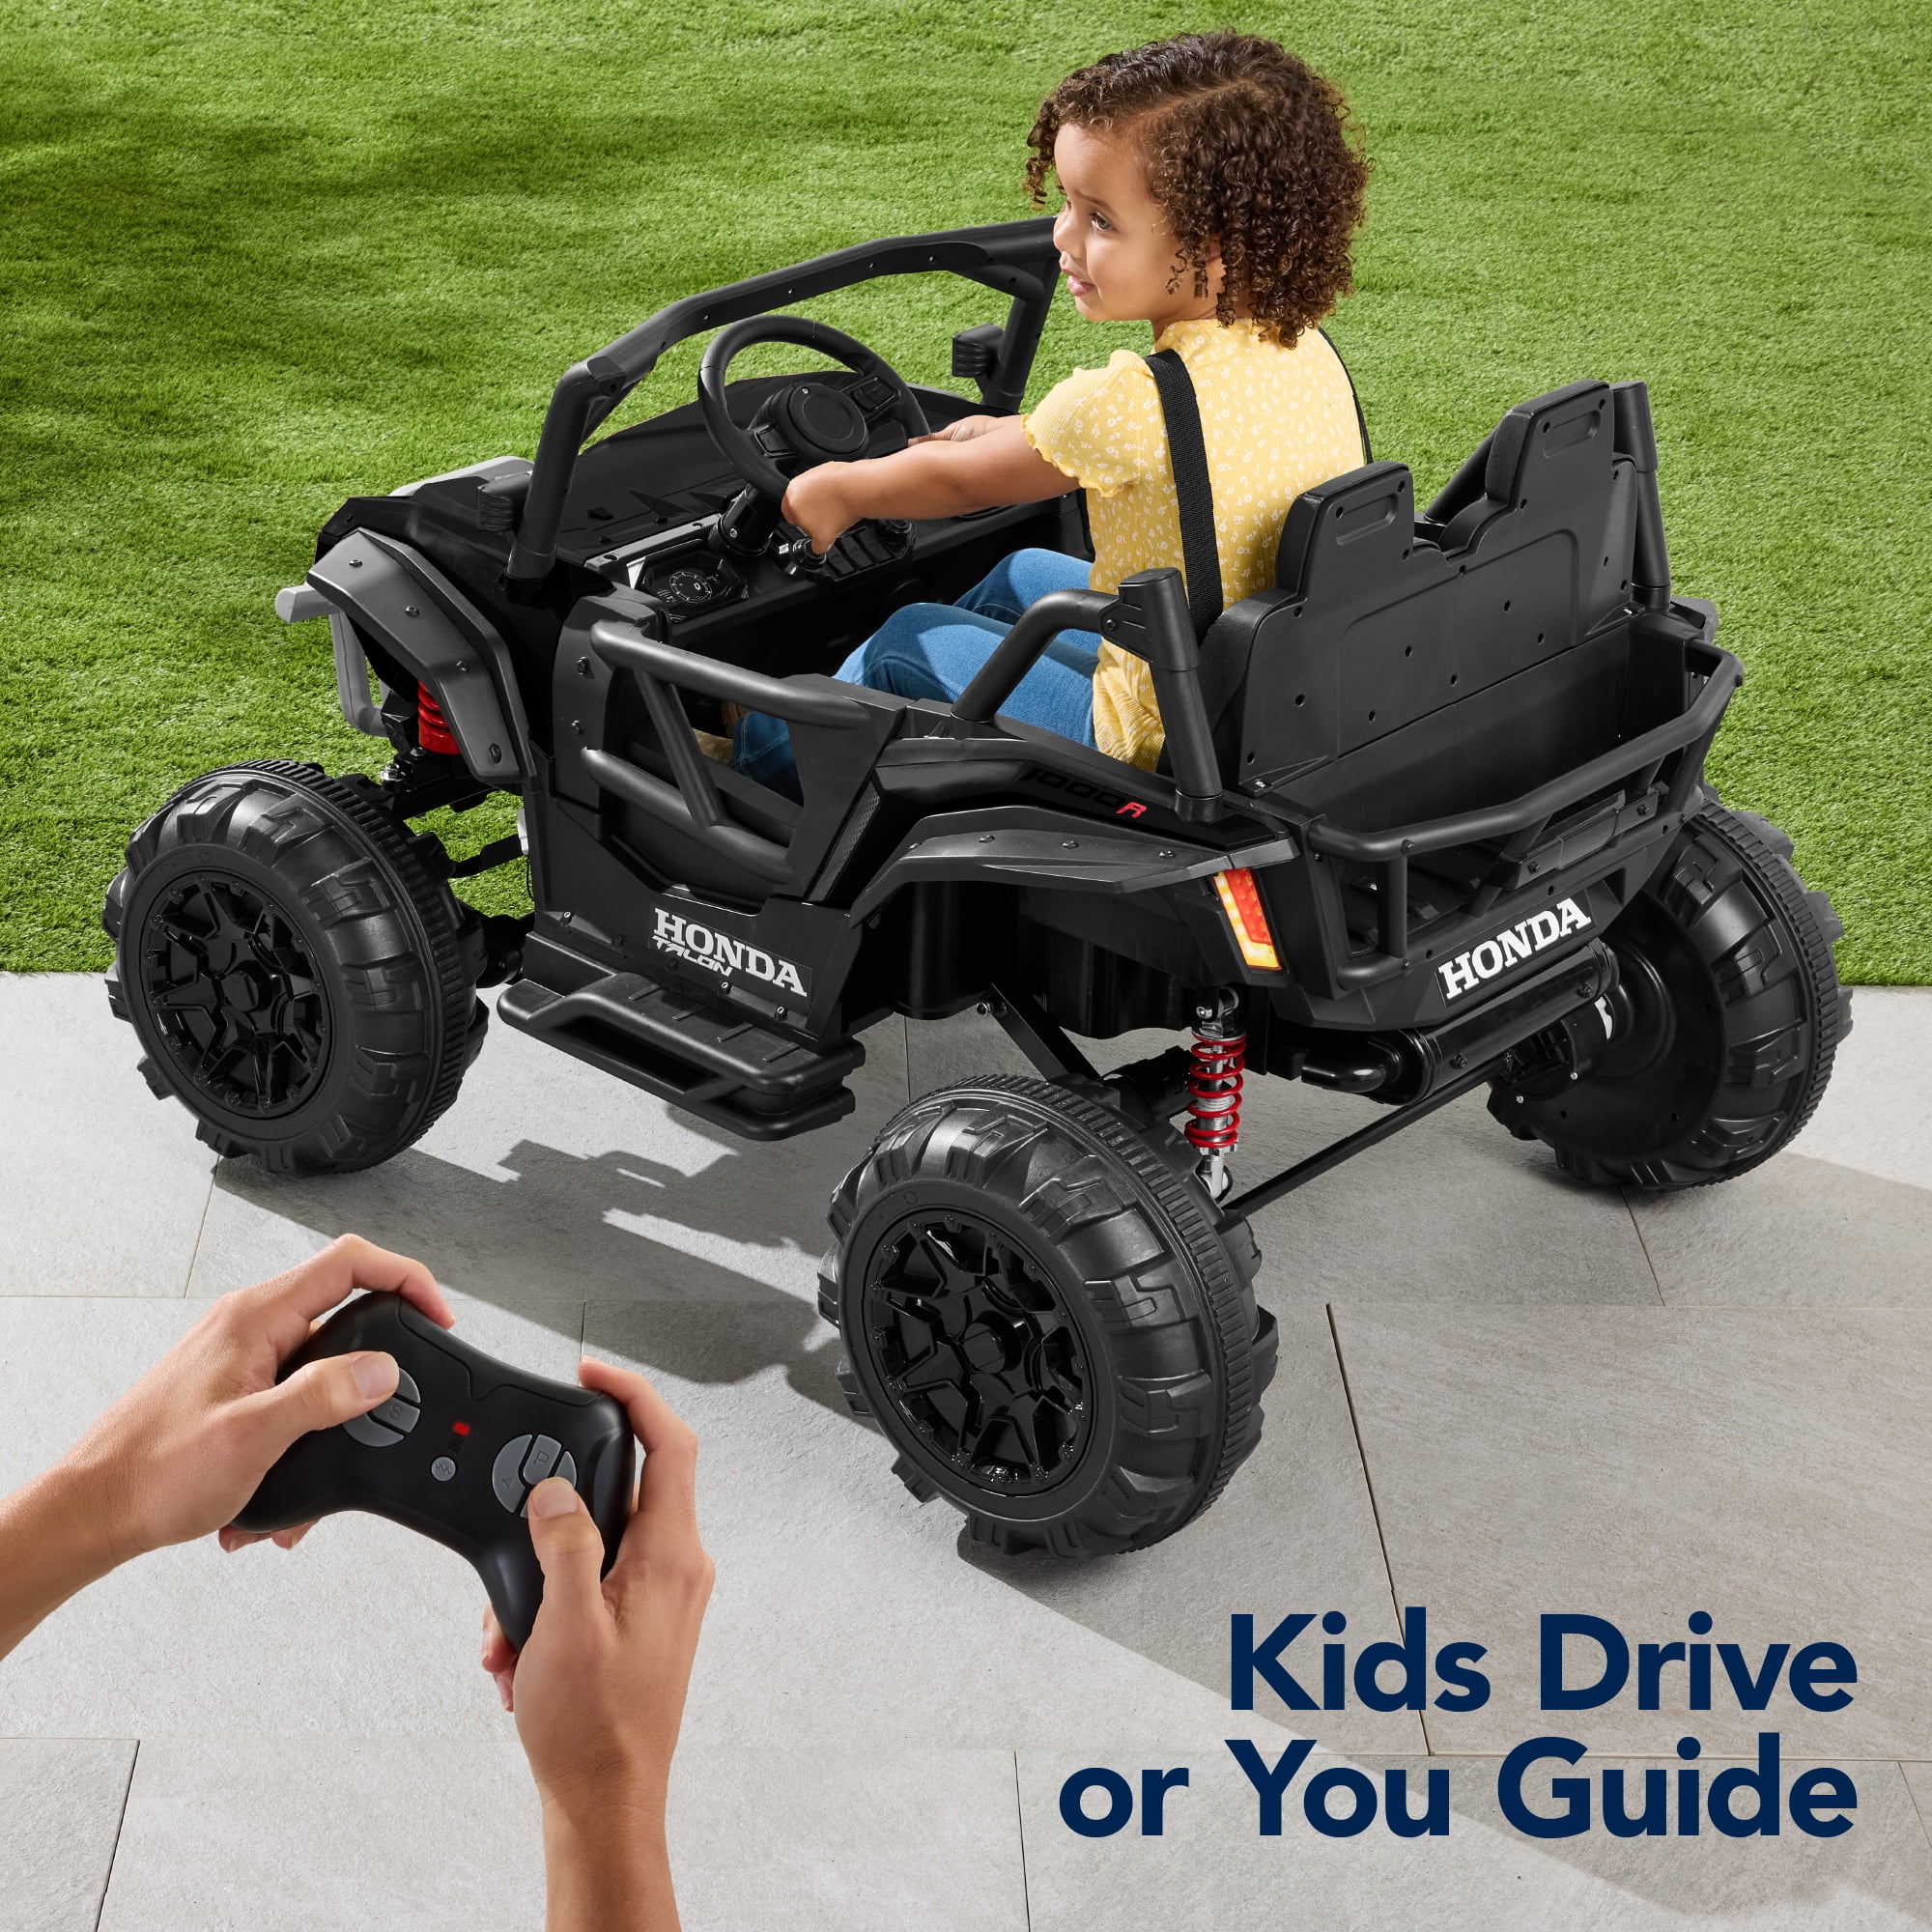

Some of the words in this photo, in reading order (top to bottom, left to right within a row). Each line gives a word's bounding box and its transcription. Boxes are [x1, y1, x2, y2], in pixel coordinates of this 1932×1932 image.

[1019, 768, 1148, 818] 1000R
[652, 935, 733, 977] TALON
[654, 907, 808, 997] HONDA
[1438, 897, 1592, 1000] HONDA
[533, 1450, 550, 1464] P
